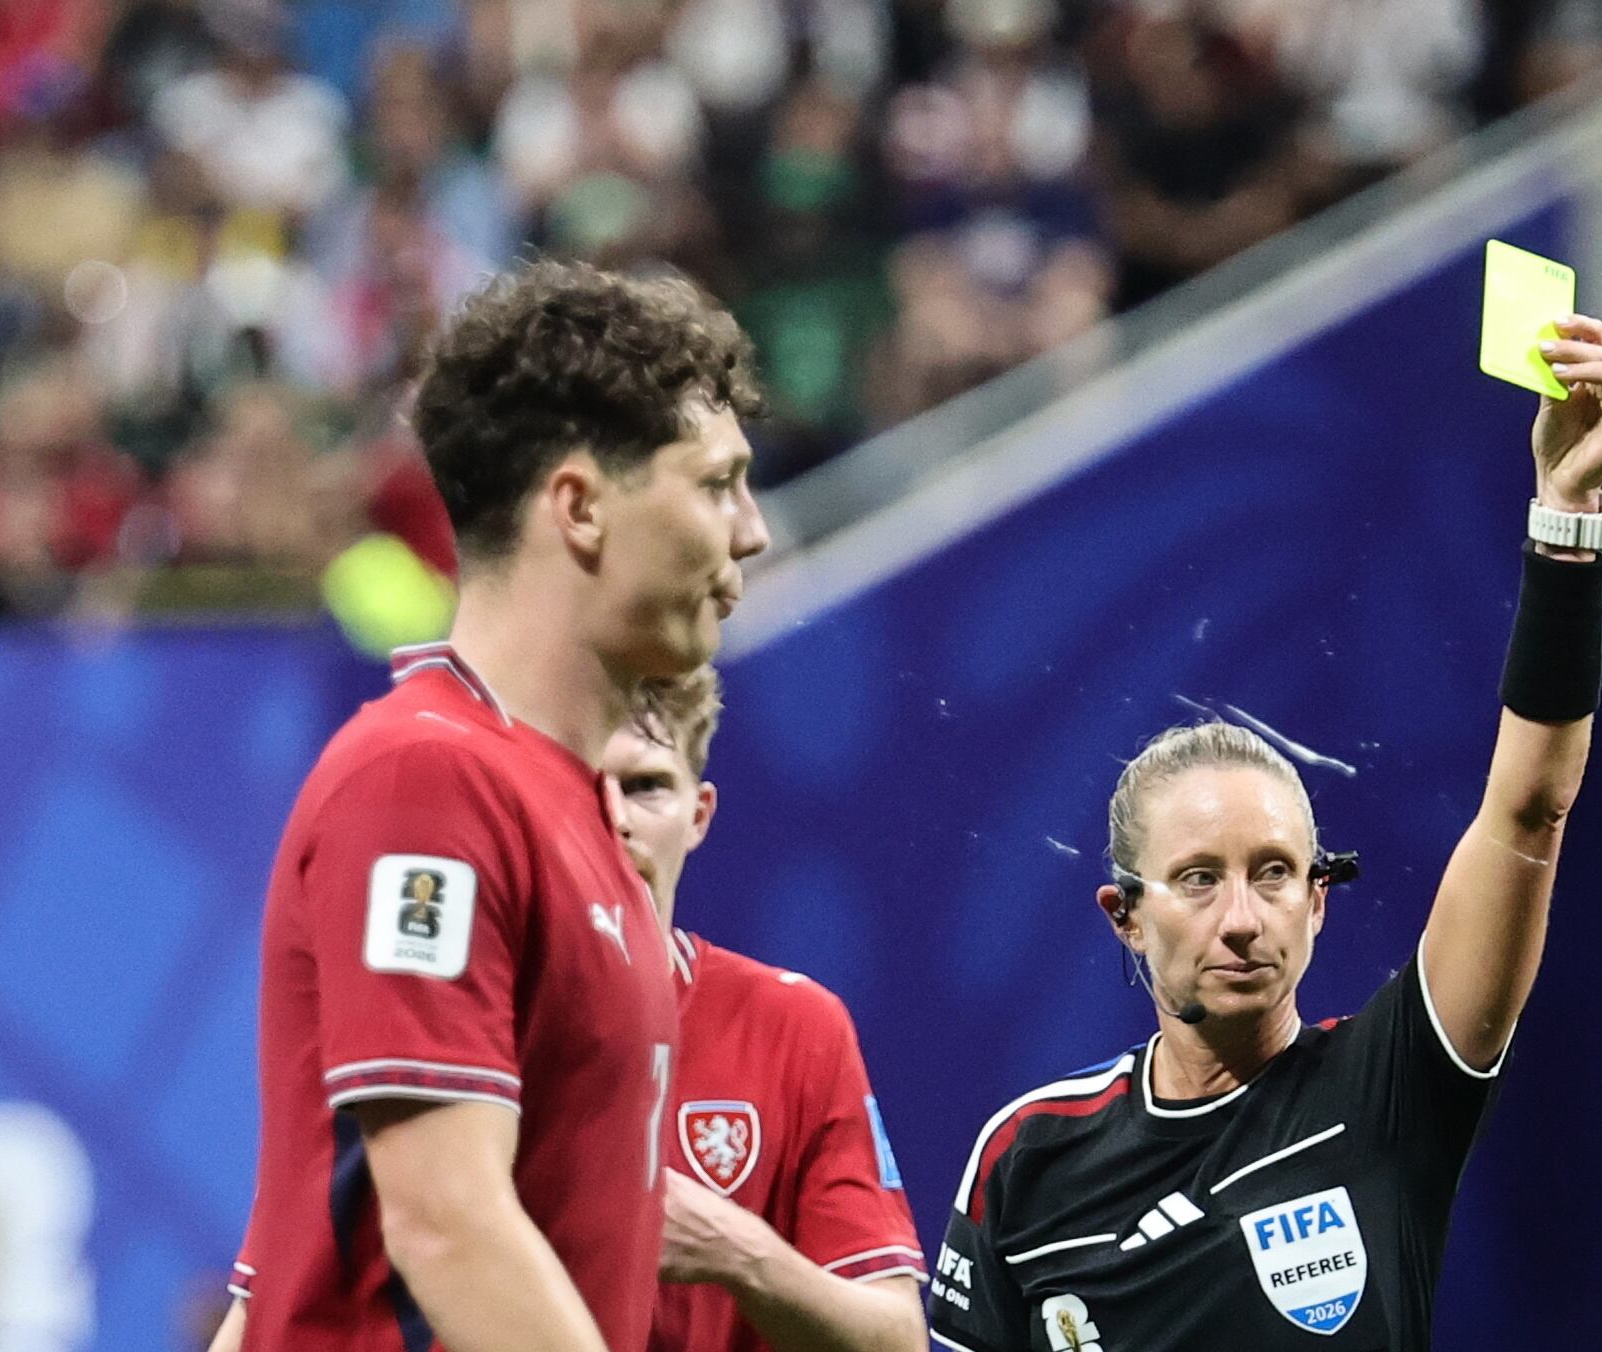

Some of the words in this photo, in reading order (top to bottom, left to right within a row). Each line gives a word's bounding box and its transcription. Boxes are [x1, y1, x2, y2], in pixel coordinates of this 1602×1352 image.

[1254, 1201, 1346, 1251] FIFA
[937, 1241, 972, 1290] IFA
[1270, 1251, 1357, 1288] REFEREE
[1305, 1300, 1346, 1324] 2026
